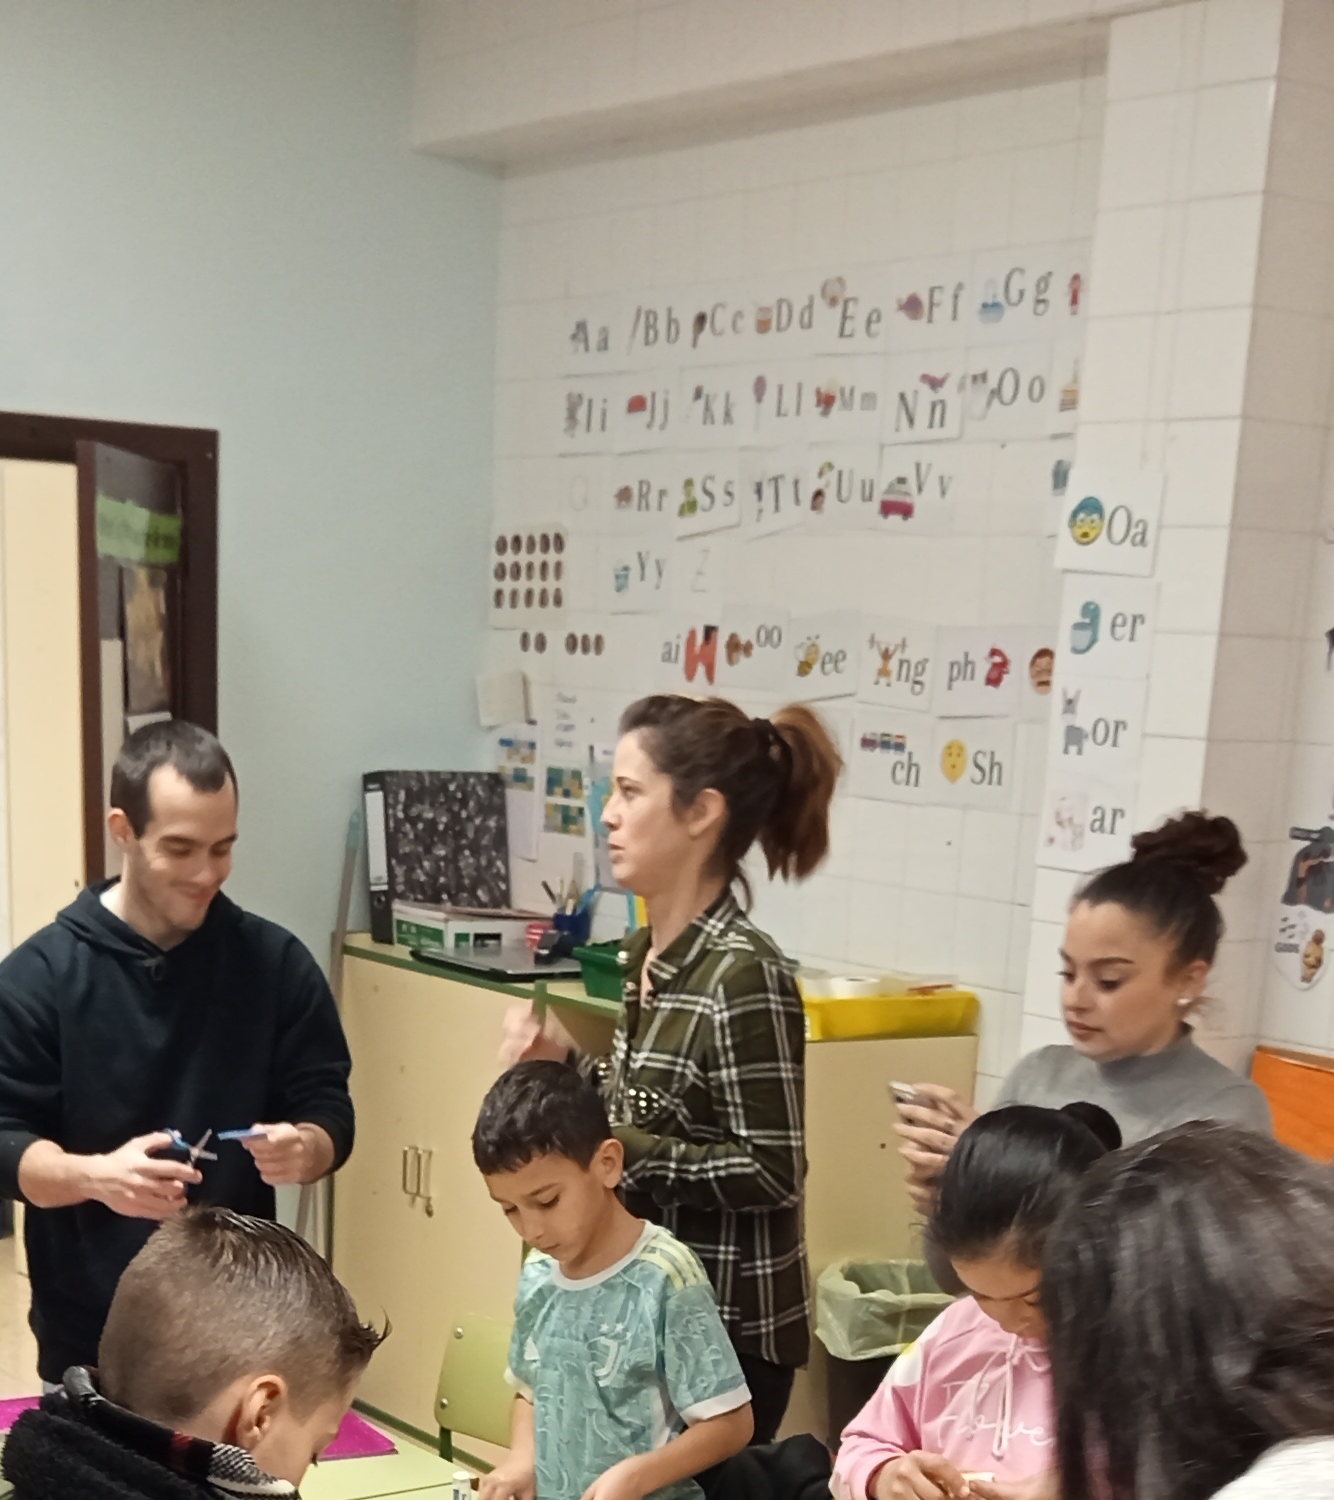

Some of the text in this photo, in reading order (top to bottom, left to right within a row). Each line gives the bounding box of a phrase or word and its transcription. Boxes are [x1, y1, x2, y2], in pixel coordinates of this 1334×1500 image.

[1109, 609, 1146, 643] er
[820, 648, 847, 676] ee
[896, 654, 929, 696] ng
[947, 651, 976, 690] ph
[1091, 716, 1128, 750] or
[890, 752, 920, 788] ch
[1088, 805, 1126, 838] ar
